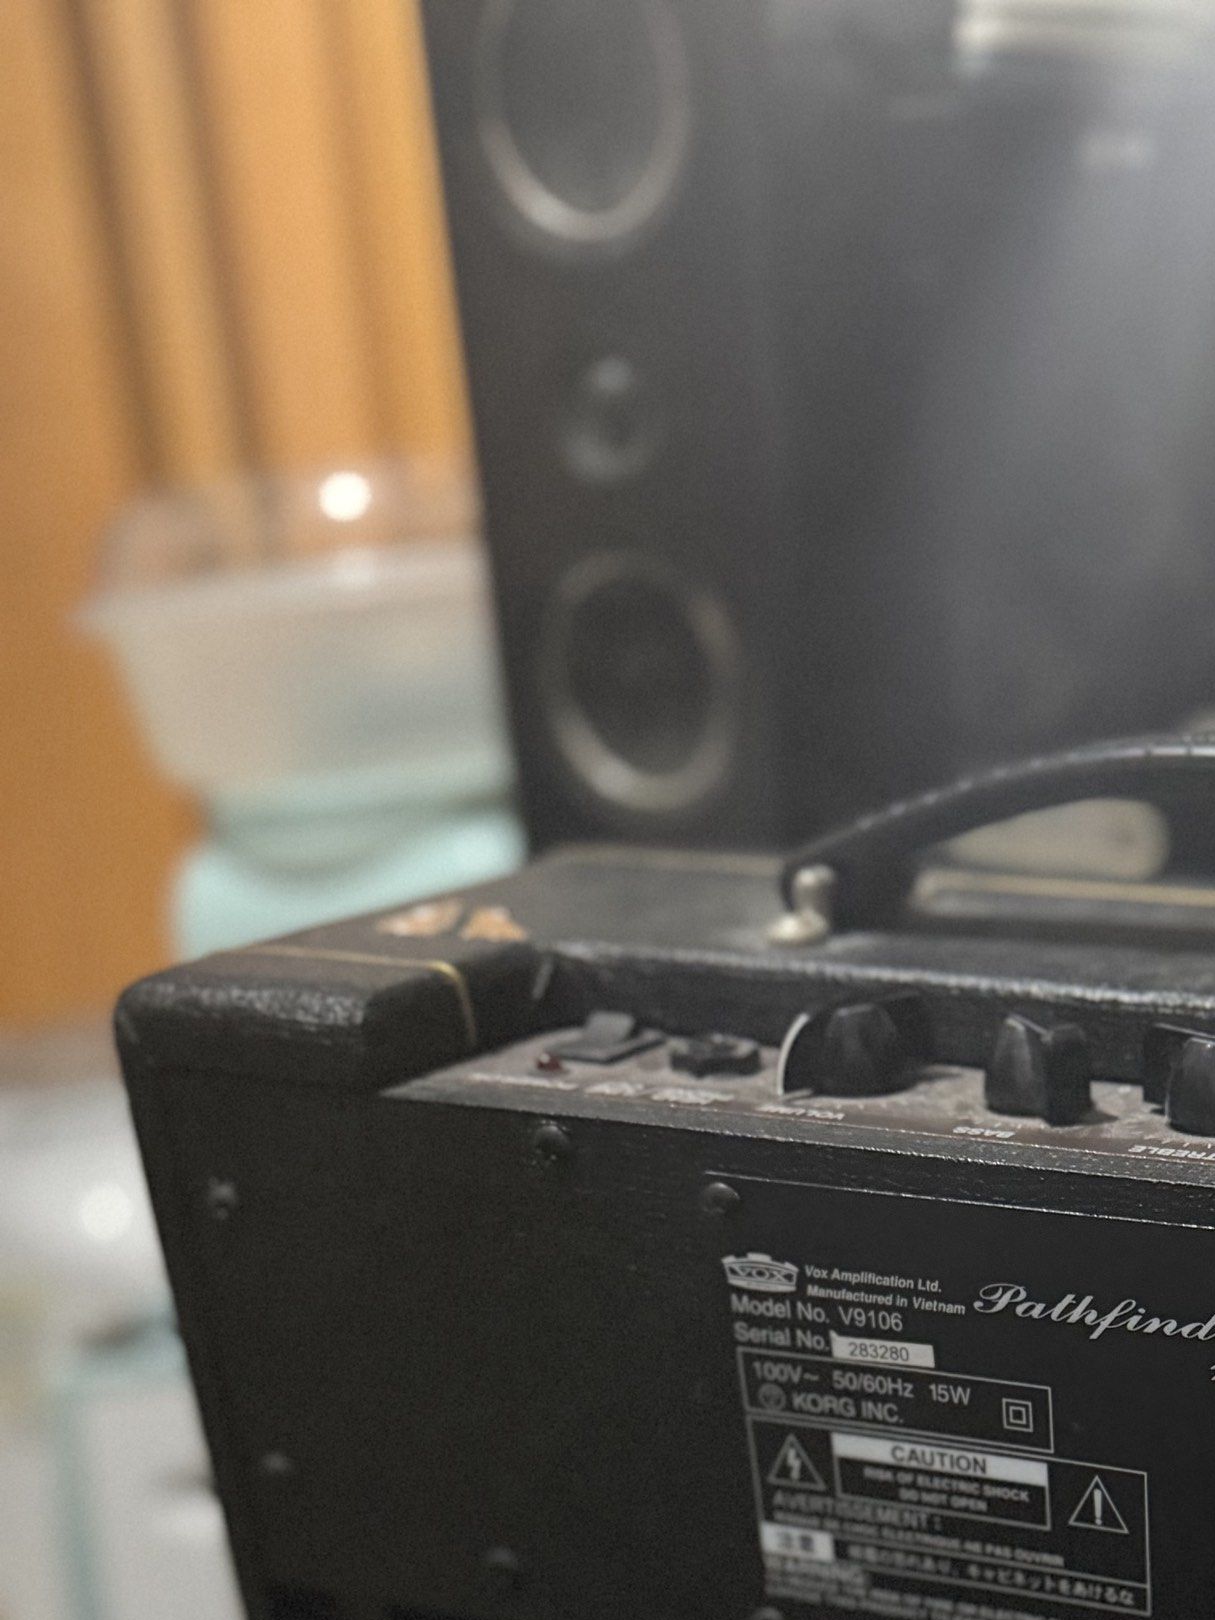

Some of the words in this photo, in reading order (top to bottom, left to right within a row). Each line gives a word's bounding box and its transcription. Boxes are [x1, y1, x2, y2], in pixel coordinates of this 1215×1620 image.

[952, 1126, 1015, 1139] BASS
[729, 1263, 795, 1284] VOX
[804, 1265, 828, 1279] Vox
[831, 1268, 914, 1289] Amplification
[917, 1278, 943, 1293] Ltd.
[731, 1293, 792, 1319] Model
[796, 1301, 830, 1324] No.
[837, 1306, 904, 1332] V9106
[806, 1285, 893, 1306] Manufactured
[896, 1295, 908, 1307] in
[912, 1297, 966, 1315] Vietnam
[733, 1321, 791, 1346] Serial
[796, 1330, 830, 1351] No.
[847, 1342, 910, 1361] 283280
[832, 1370, 914, 1398] 50/60Hz
[929, 1383, 970, 1406] 15W
[791, 1392, 856, 1418] KORG
[861, 1400, 905, 1424] INC.
[890, 1445, 987, 1475] CAUTION
[949, 1495, 988, 1513] OPEN
[983, 1484, 1030, 1503] SHOCK
